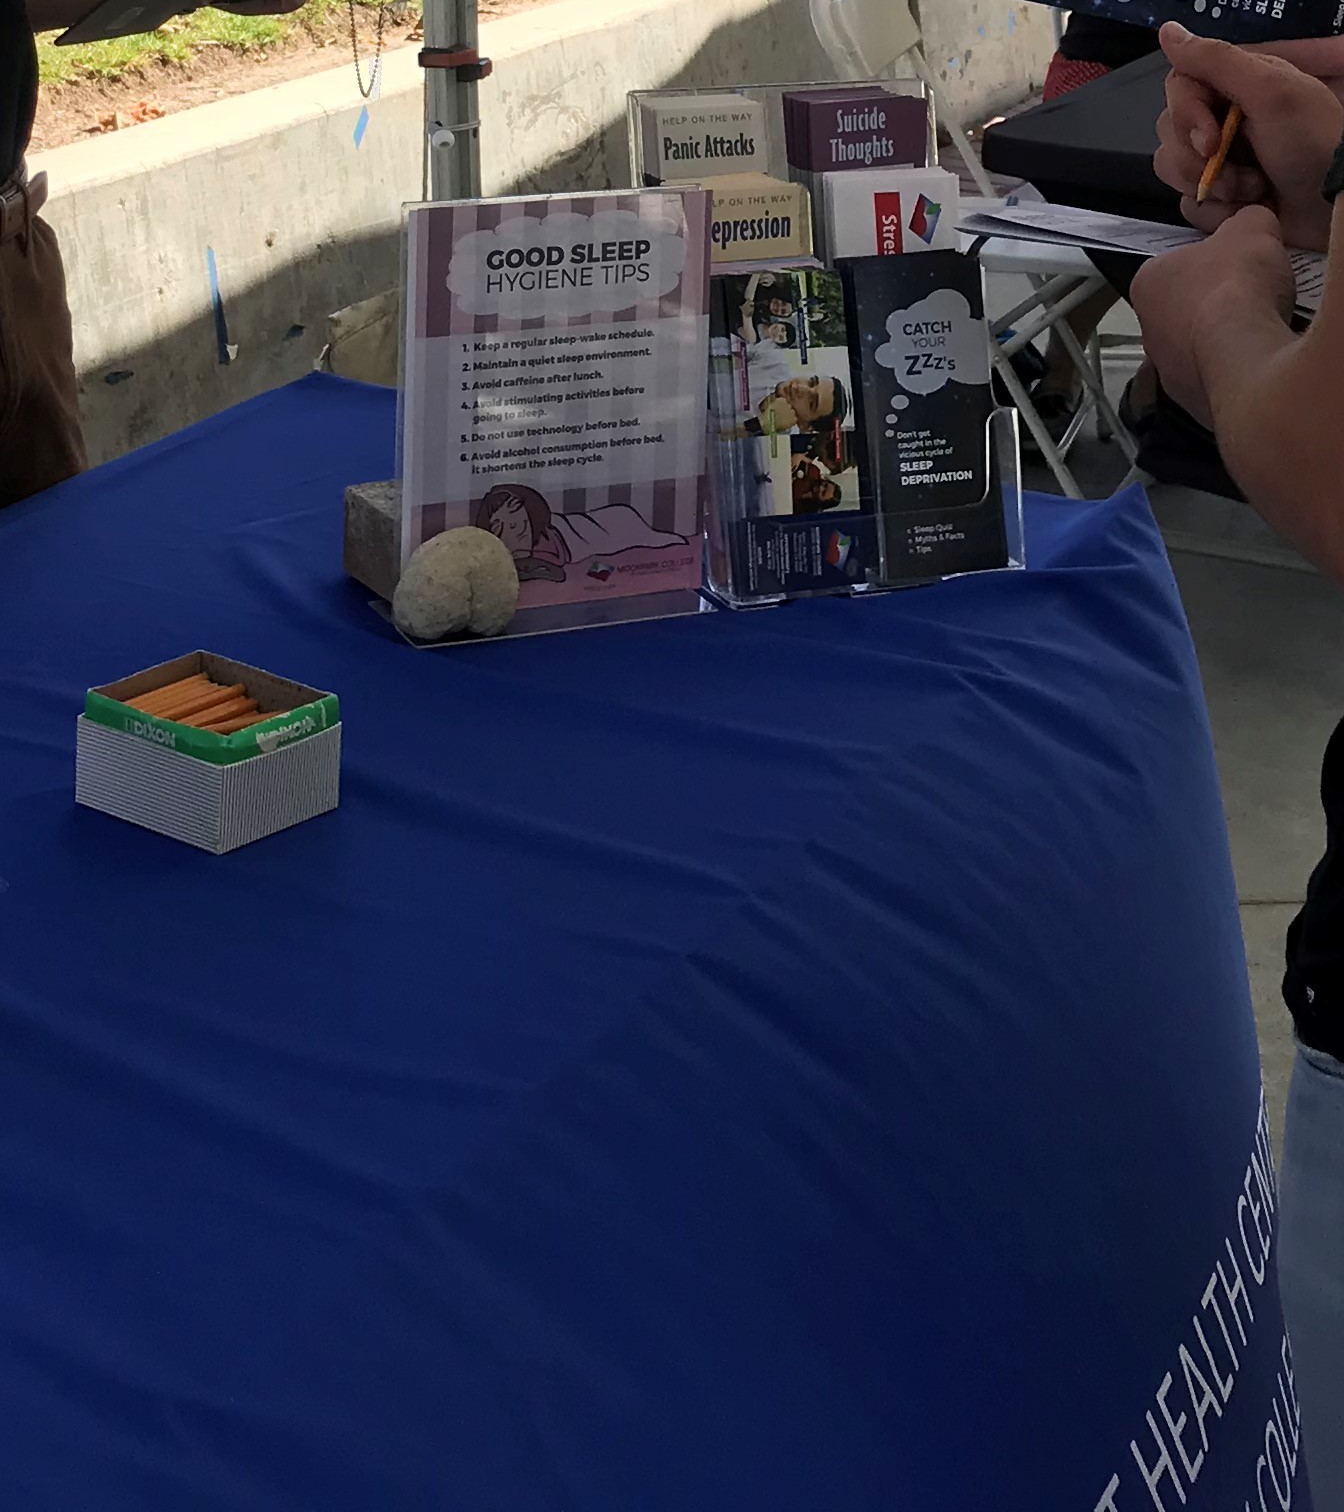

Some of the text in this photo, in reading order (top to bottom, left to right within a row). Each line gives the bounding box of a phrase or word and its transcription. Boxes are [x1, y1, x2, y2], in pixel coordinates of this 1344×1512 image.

[662, 112, 753, 126] HELP ON THE WAY
[836, 106, 886, 133] Suicide
[663, 132, 755, 161] Panic Attacks
[829, 136, 894, 165] Thoughts
[712, 194, 793, 208] LP ON THE WAY
[711, 210, 791, 251] epression
[486, 239, 651, 271] GOOD SLEEP
[486, 262, 650, 294] HYGIENE TIPS
[902, 320, 952, 336] CATCH
[473, 342, 501, 352] Keep
[502, 341, 508, 349] a
[511, 337, 548, 350] regular
[549, 332, 607, 346] sleep-wake
[608, 329, 655, 341] schedule.
[911, 336, 946, 348] YOUR
[462, 347, 653, 372] 2. Maintain a quiet sleep environment.
[461, 370, 604, 391] 3. Avoid caffeine after lunch.
[461, 385, 645, 410] 4. Avoid stimulating activities before
[473, 408, 548, 425] going to sleep.
[460, 417, 641, 443] 5. Do not use technology before bed.
[896, 430, 931, 439] Don't get
[460, 454, 470, 462] 6.
[471, 450, 501, 461] Avoid
[503, 446, 540, 458] alcohol
[542, 440, 608, 454] consumption
[610, 436, 642, 447] before
[924, 439, 932, 447] in
[933, 438, 946, 446] the
[945, 446, 954, 455] of
[481, 459, 527, 473] shortens
[529, 459, 546, 468] the
[547, 456, 575, 467] sleep
[576, 452, 605, 464] cycle.
[899, 460, 934, 472] SLEEP
[901, 469, 973, 486] DEPRIVATION
[134, 721, 176, 749] DIXON
[1130, 1078, 1280, 1512] HEALTH CENT
[1256, 1328, 1300, 1512] COLLE
